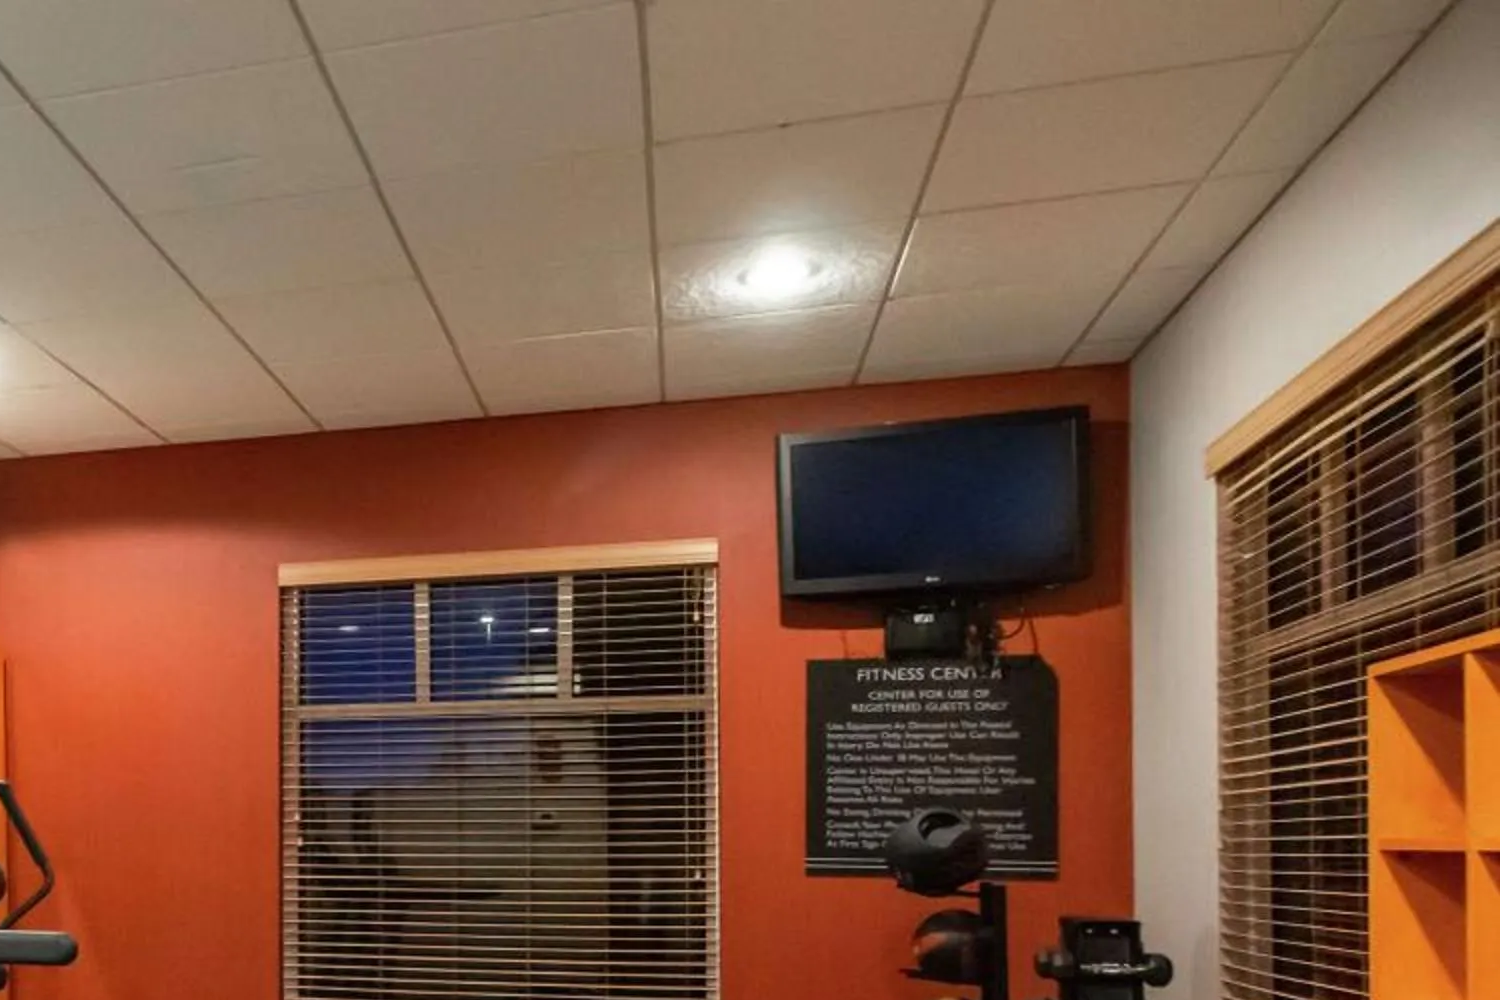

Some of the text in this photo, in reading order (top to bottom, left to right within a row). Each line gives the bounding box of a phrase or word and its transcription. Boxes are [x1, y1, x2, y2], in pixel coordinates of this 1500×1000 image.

[856, 666, 925, 683] FITNESS
[867, 688, 990, 701] CENTER FOR USE OF
[851, 701, 1009, 713] REGISTERED GUESTS ONLY
